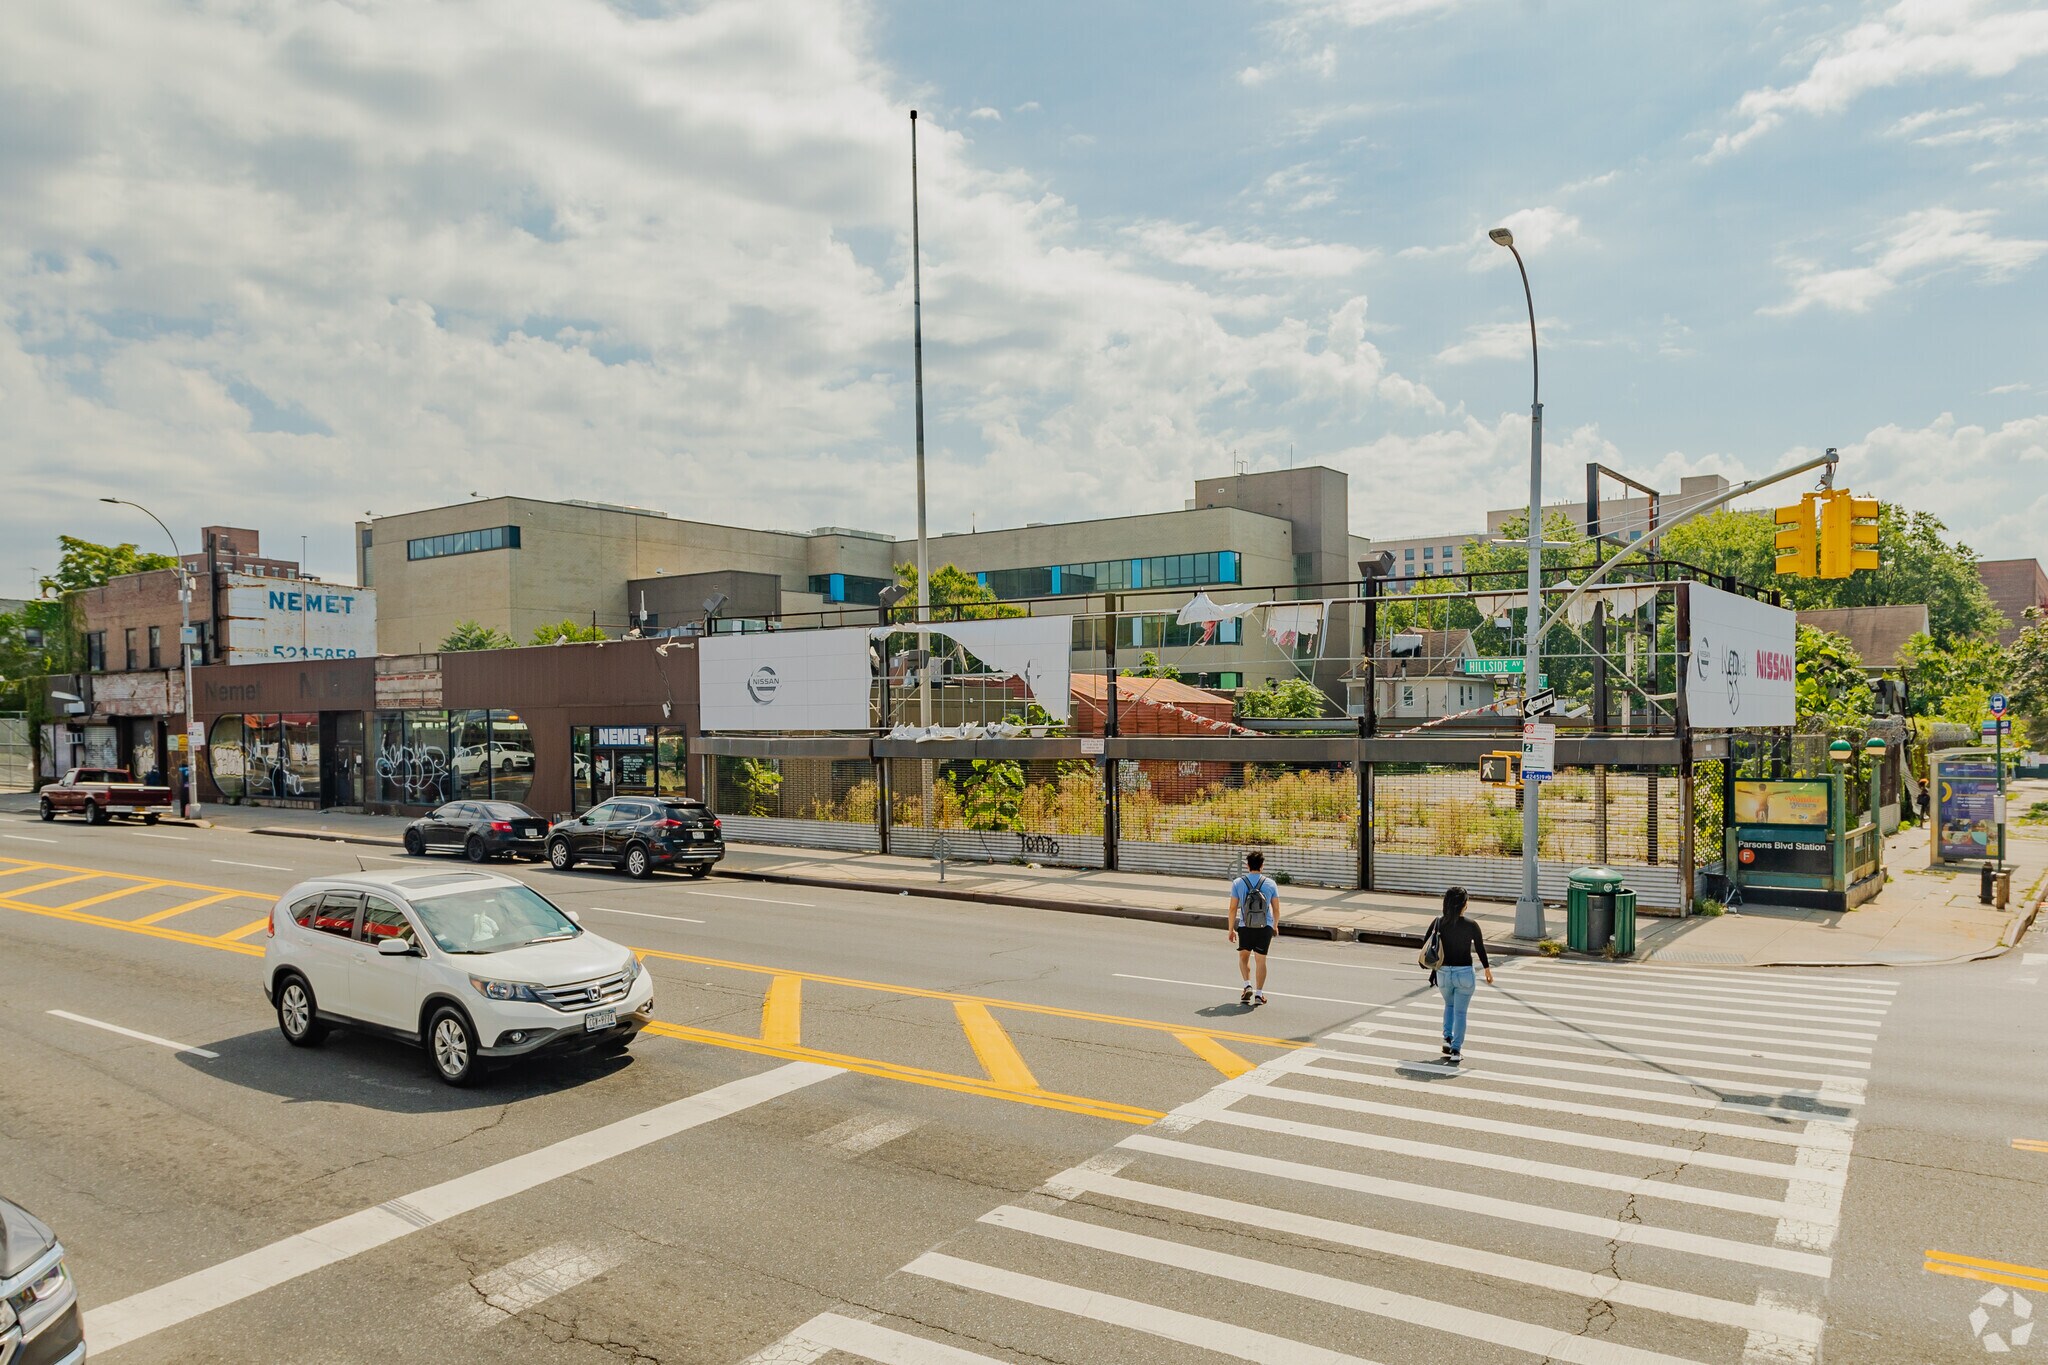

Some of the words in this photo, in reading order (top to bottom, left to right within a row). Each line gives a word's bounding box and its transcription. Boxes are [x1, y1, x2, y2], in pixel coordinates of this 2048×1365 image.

[268, 590, 355, 614] NEMET
[1469, 661, 1508, 672] HILLSIDE
[1756, 649, 1792, 682] NISSAN
[598, 728, 647, 745] NEMET
[1738, 841, 1772, 849] Parsons
[1774, 841, 1793, 850] Blvd
[1795, 842, 1826, 851] Station
[1743, 852, 1750, 861] F
